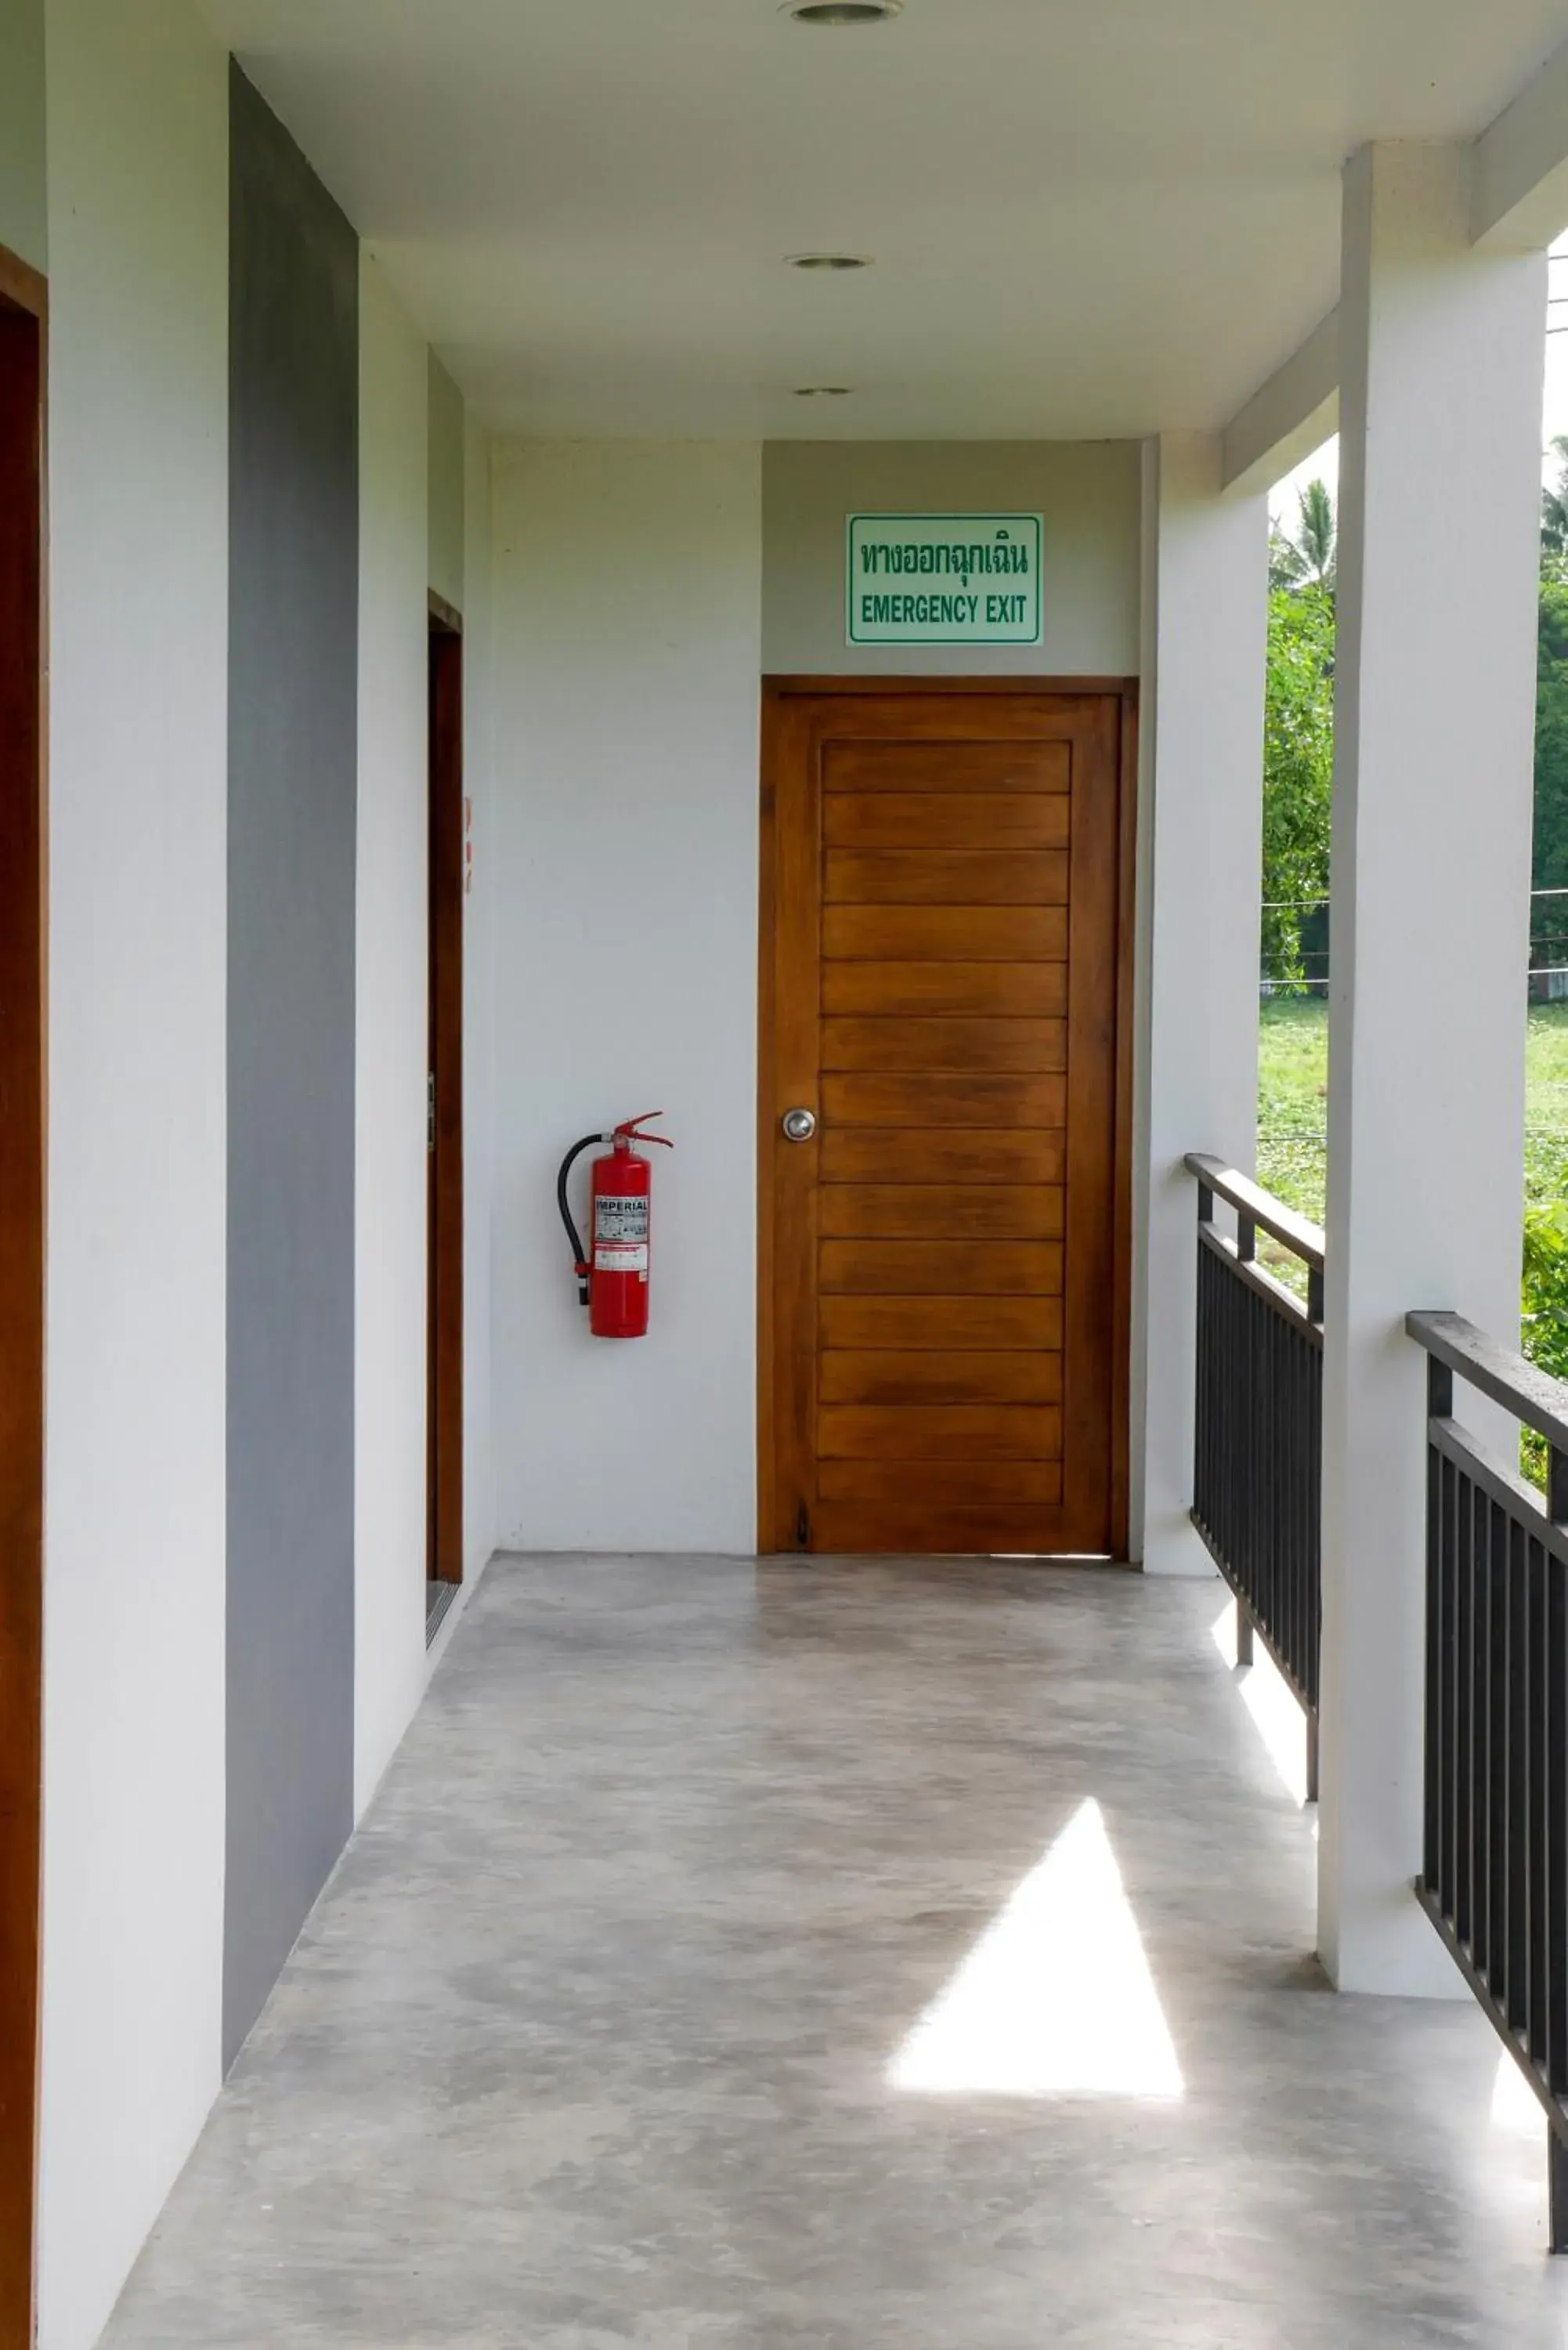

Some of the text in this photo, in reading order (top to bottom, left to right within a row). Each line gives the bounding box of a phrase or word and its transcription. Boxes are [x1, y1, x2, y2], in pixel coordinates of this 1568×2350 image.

[861, 530, 1028, 588] ทางออกฉุกเฉิน
[862, 595, 1027, 624] EMERGENCY EXIT
